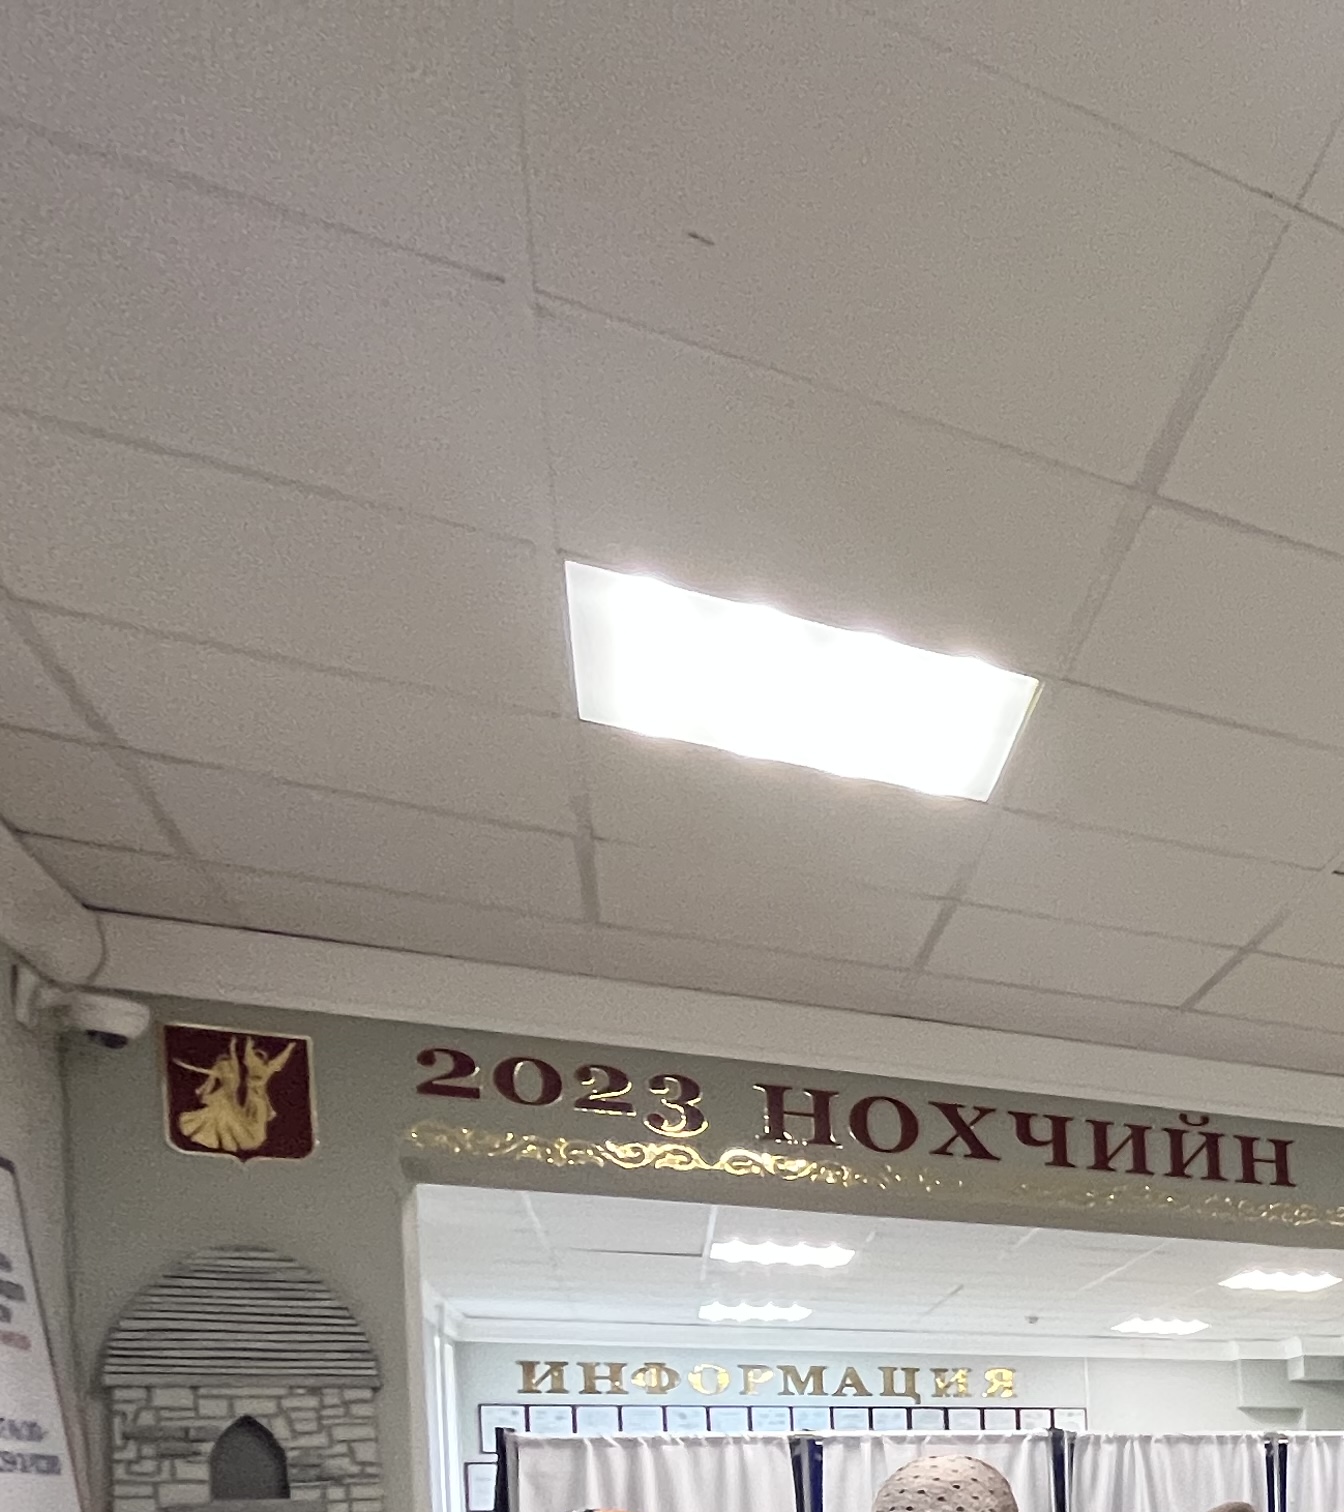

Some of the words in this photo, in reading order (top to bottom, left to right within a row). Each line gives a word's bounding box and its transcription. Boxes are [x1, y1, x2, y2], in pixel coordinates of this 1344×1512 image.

[415, 1047, 709, 1138] 2023
[752, 1083, 1297, 1188] НОХЧИЙН
[515, 1359, 1018, 1405] ИНФОРМАЦИЯ
